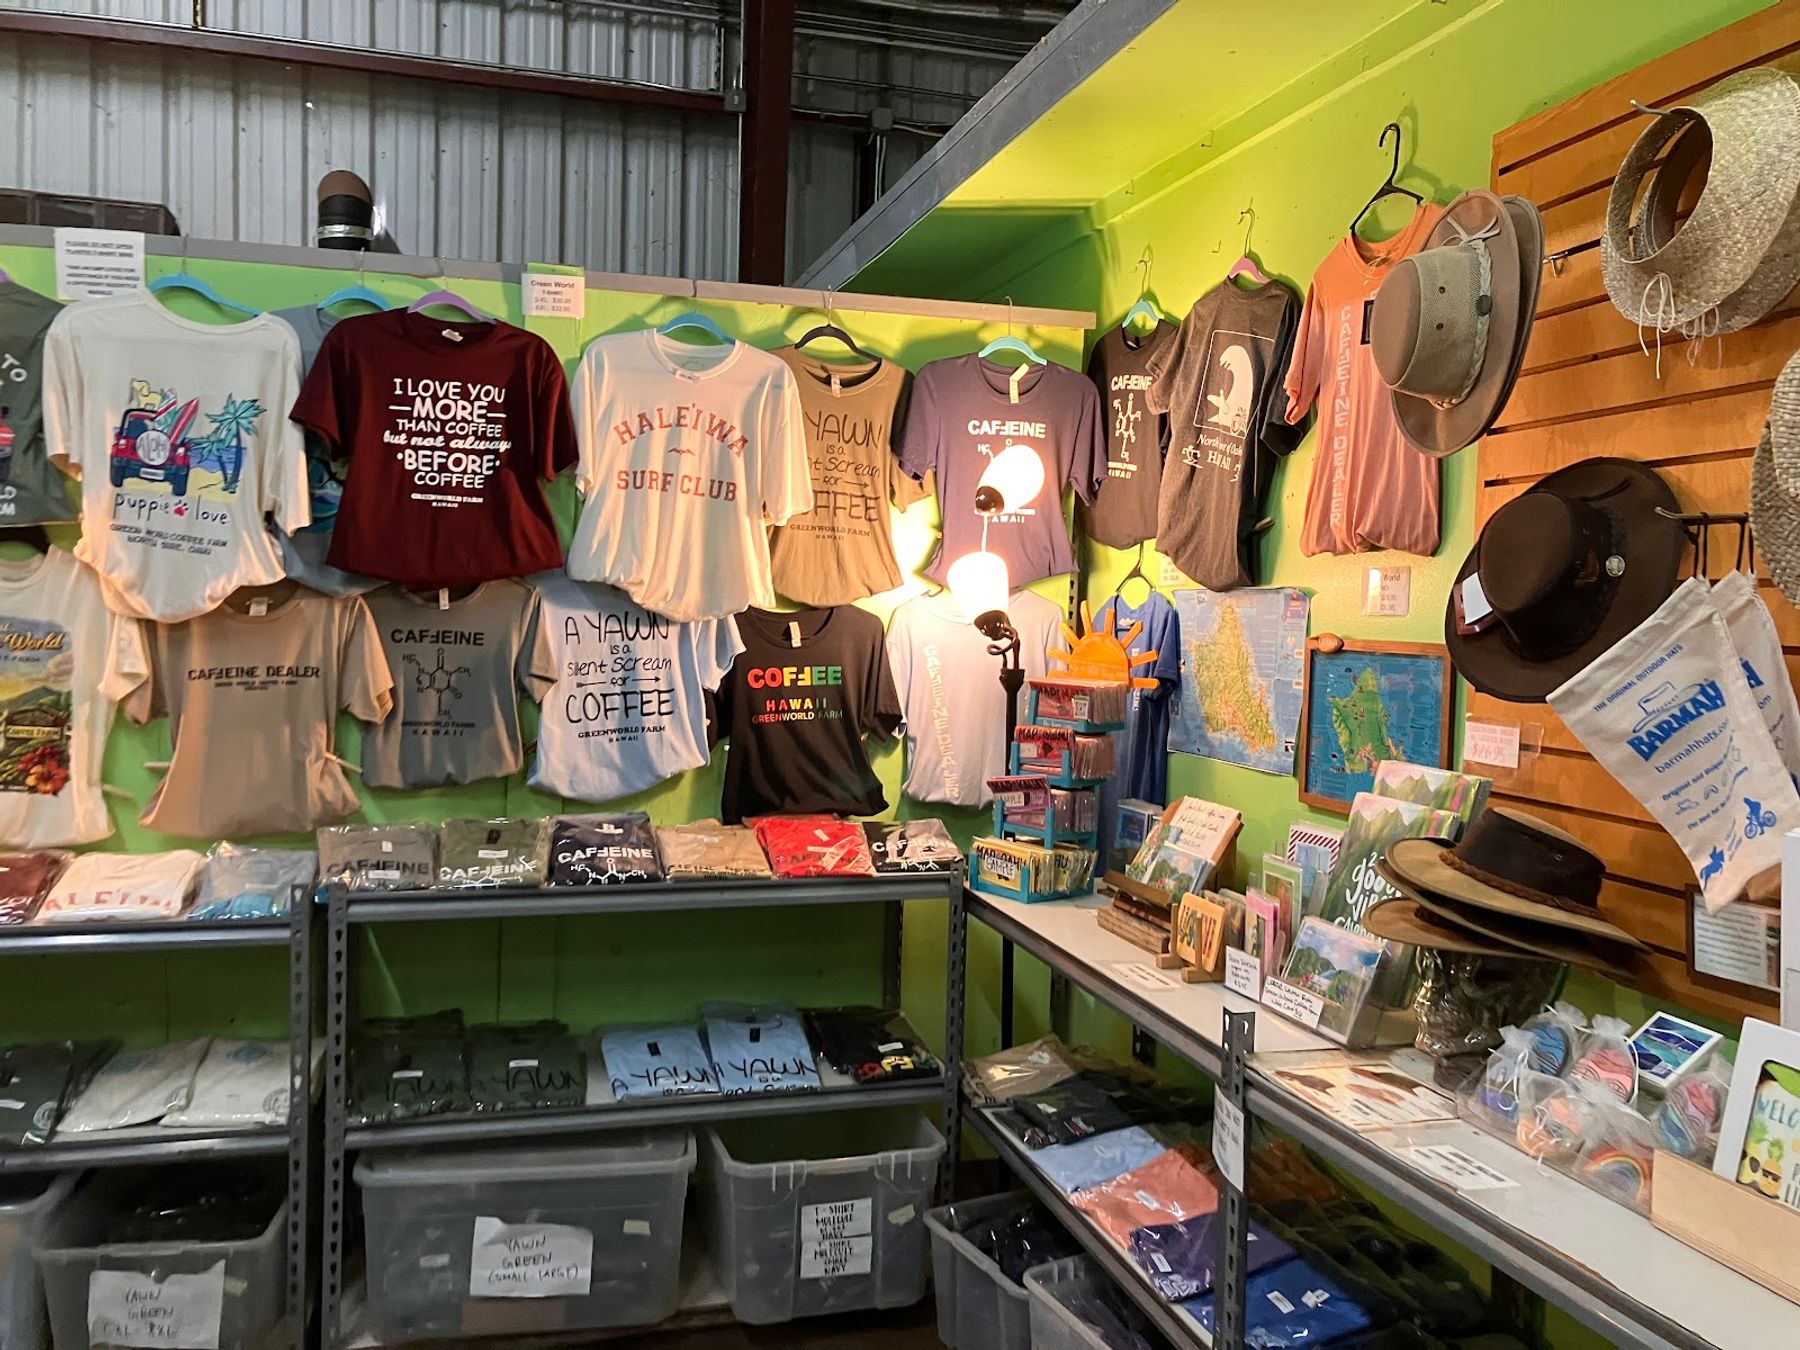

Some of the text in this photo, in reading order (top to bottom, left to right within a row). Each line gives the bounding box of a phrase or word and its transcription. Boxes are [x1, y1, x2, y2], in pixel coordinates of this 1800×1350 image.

[2, 354, 28, 382] TO
[394, 378, 506, 403] I LOVE YOU
[412, 396, 488, 423] MORE
[396, 419, 502, 438] THAN COFFEE
[805, 411, 882, 449] YAWN
[968, 420, 1046, 438] CAFFEINE
[384, 430, 408, 445] but
[410, 435, 446, 448] not
[1196, 434, 1220, 448] North
[826, 444, 846, 456] is a
[404, 449, 496, 475] BEFORE
[414, 472, 486, 488] COFFEE
[617, 470, 738, 502] SURF CLUB
[1330, 436, 1348, 526] DEALER
[196, 494, 228, 524] love
[813, 490, 880, 522] FFEE
[992, 515, 1025, 524] AWAII
[790, 524, 871, 537] GREENWORLD FARM
[565, 611, 670, 644] A YAWN
[6, 632, 64, 650] World
[391, 629, 484, 646] CAFFEINE
[610, 644, 632, 654] is a
[266, 665, 320, 679] DEALER
[747, 666, 842, 688] COFFEE
[1593, 643, 1684, 712] THE ORIGINAL OUTDOOR HATS
[610, 676, 630, 688] for
[566, 688, 674, 724] COFFEE
[766, 698, 827, 712] HAWAII
[752, 710, 842, 724] GREENWORLD FARM
[1626, 679, 1726, 762] BARMAH
[578, 726, 666, 738] GREENWORLD FARM
[558, 846, 654, 864] CAFFEINE
[728, 1058, 816, 1078] YAWN
[612, 1066, 714, 1100] A YAWN
[1756, 1093, 1800, 1129] WELC
[507, 1235, 546, 1252] YAWN
[502, 1252, 552, 1268] GREEN
